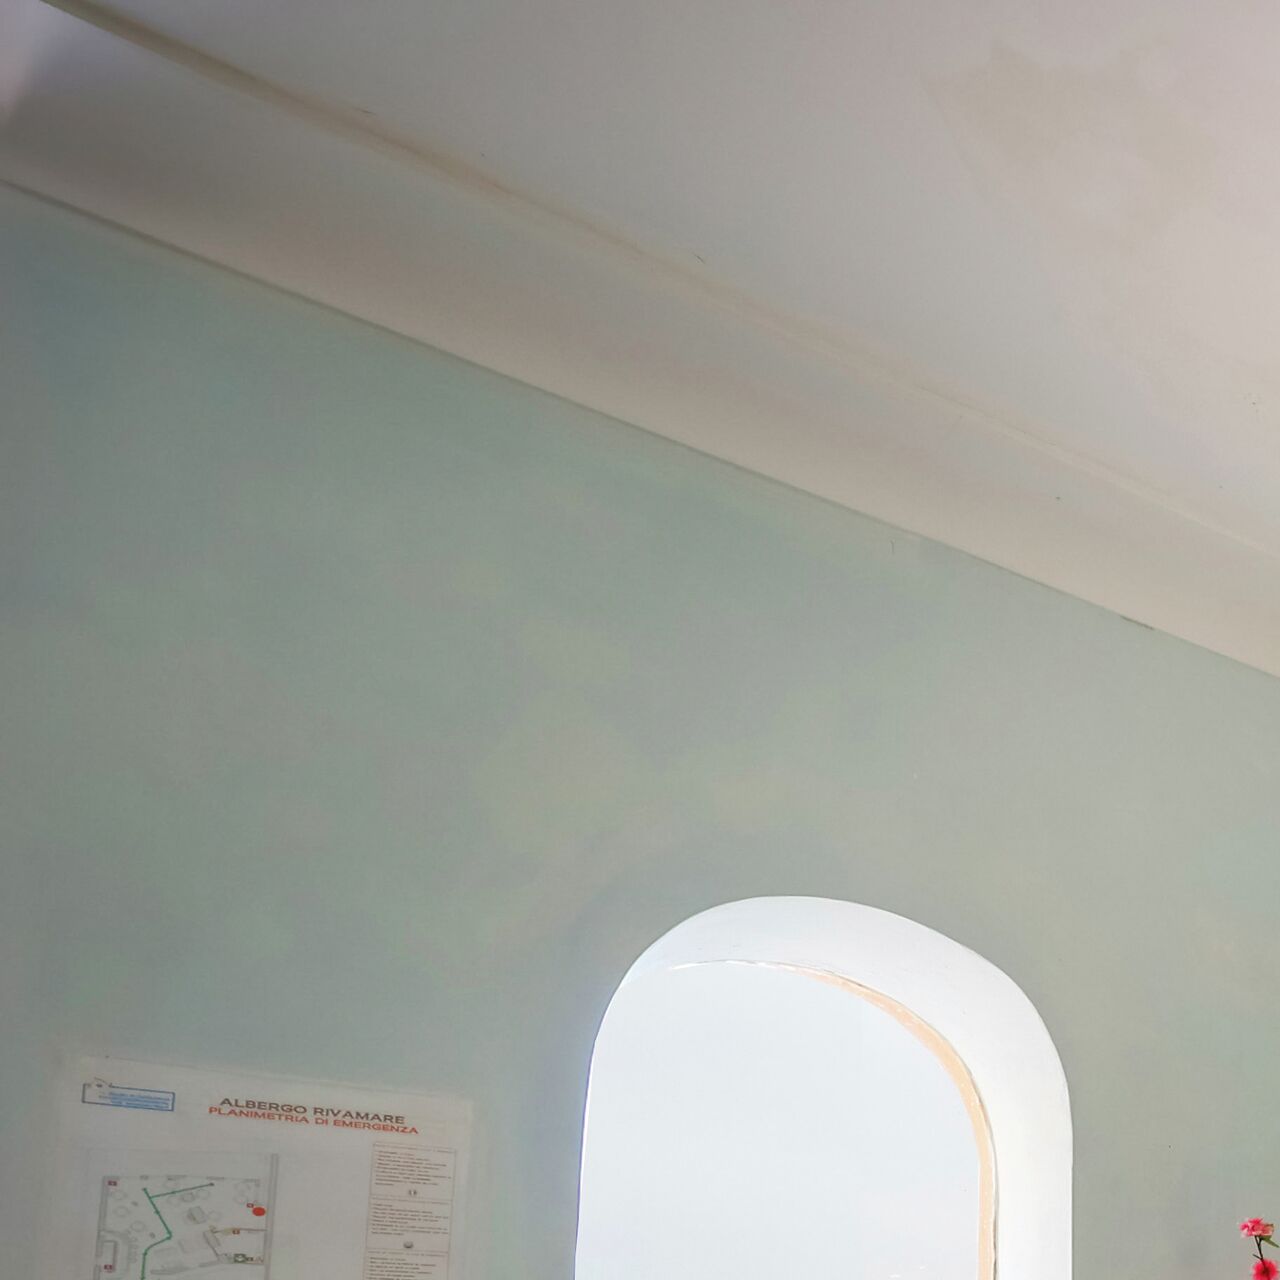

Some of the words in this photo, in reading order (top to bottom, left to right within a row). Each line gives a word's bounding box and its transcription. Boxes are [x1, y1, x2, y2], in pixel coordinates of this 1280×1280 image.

[208, 1107, 309, 1124] PLANIMETRIA
[315, 1116, 329, 1126] DI
[333, 1119, 419, 1135] EMERGENZA
[220, 1098, 307, 1115] ALBERGO
[313, 1106, 405, 1125] RIVAMARE
